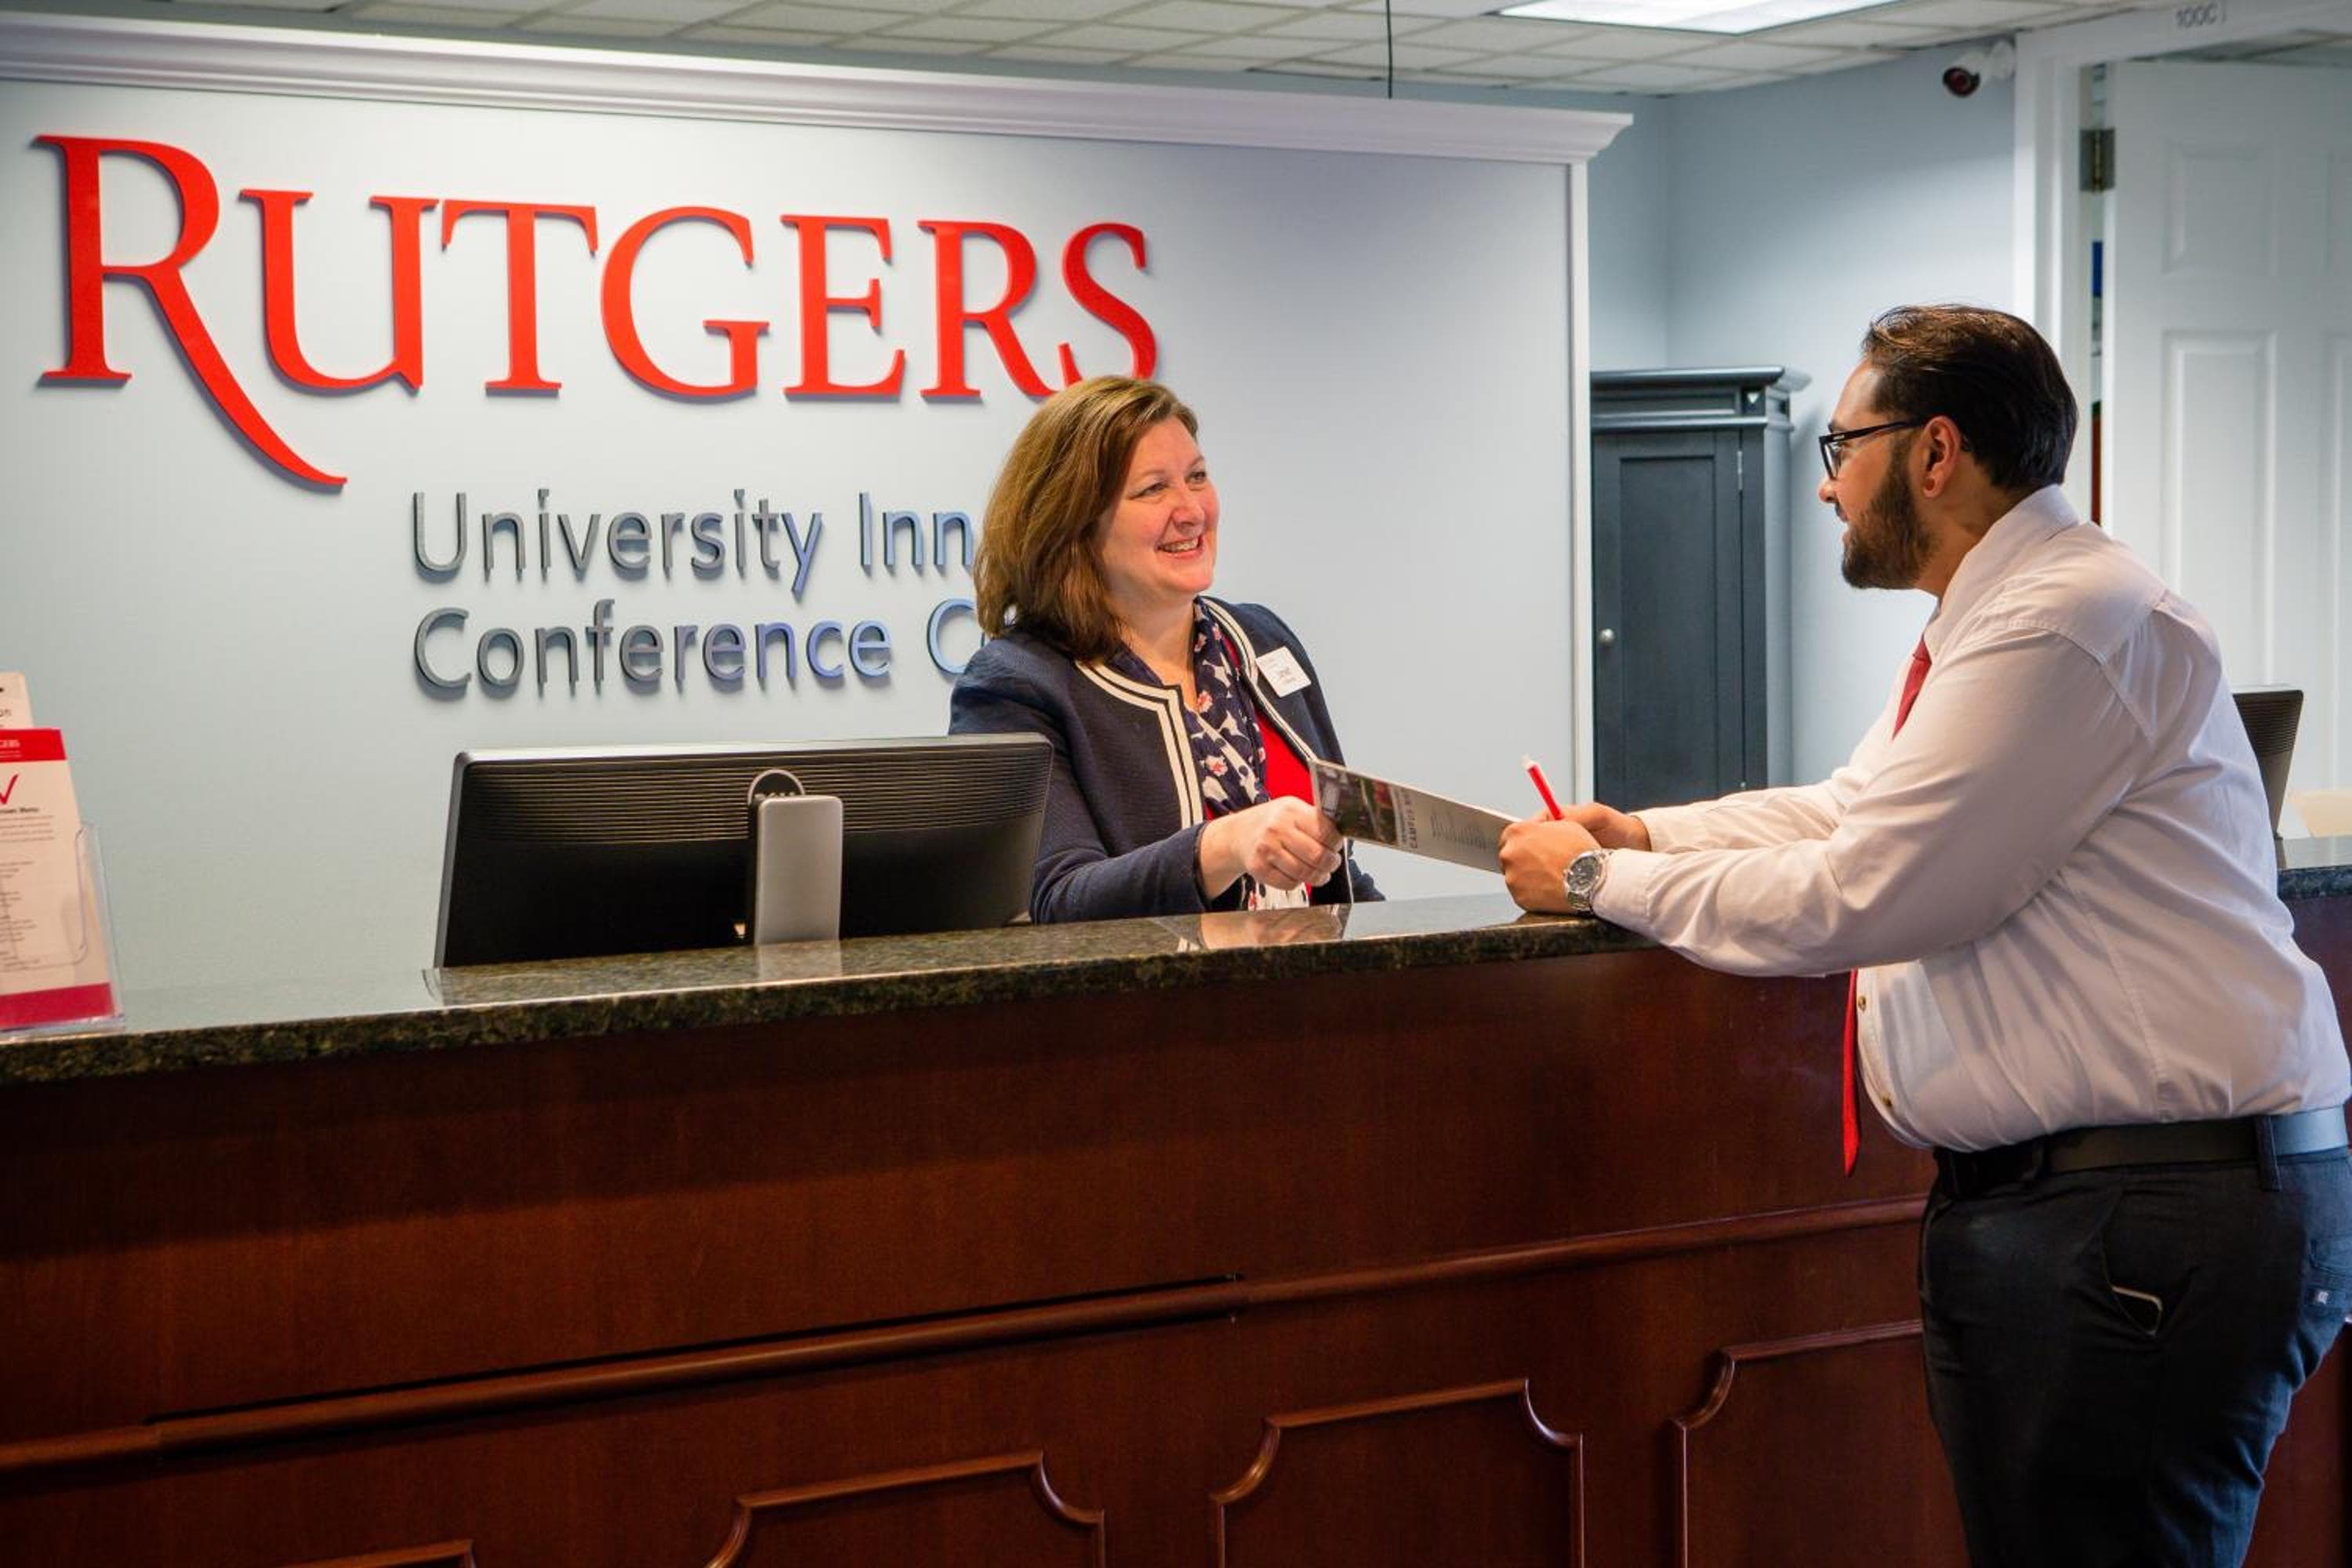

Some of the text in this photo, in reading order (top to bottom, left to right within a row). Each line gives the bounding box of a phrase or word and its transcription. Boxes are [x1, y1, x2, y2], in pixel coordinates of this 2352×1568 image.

[37, 135, 1160, 486] RUTGERS
[413, 488, 975, 594] University Inn
[413, 598, 985, 687] Conference C
